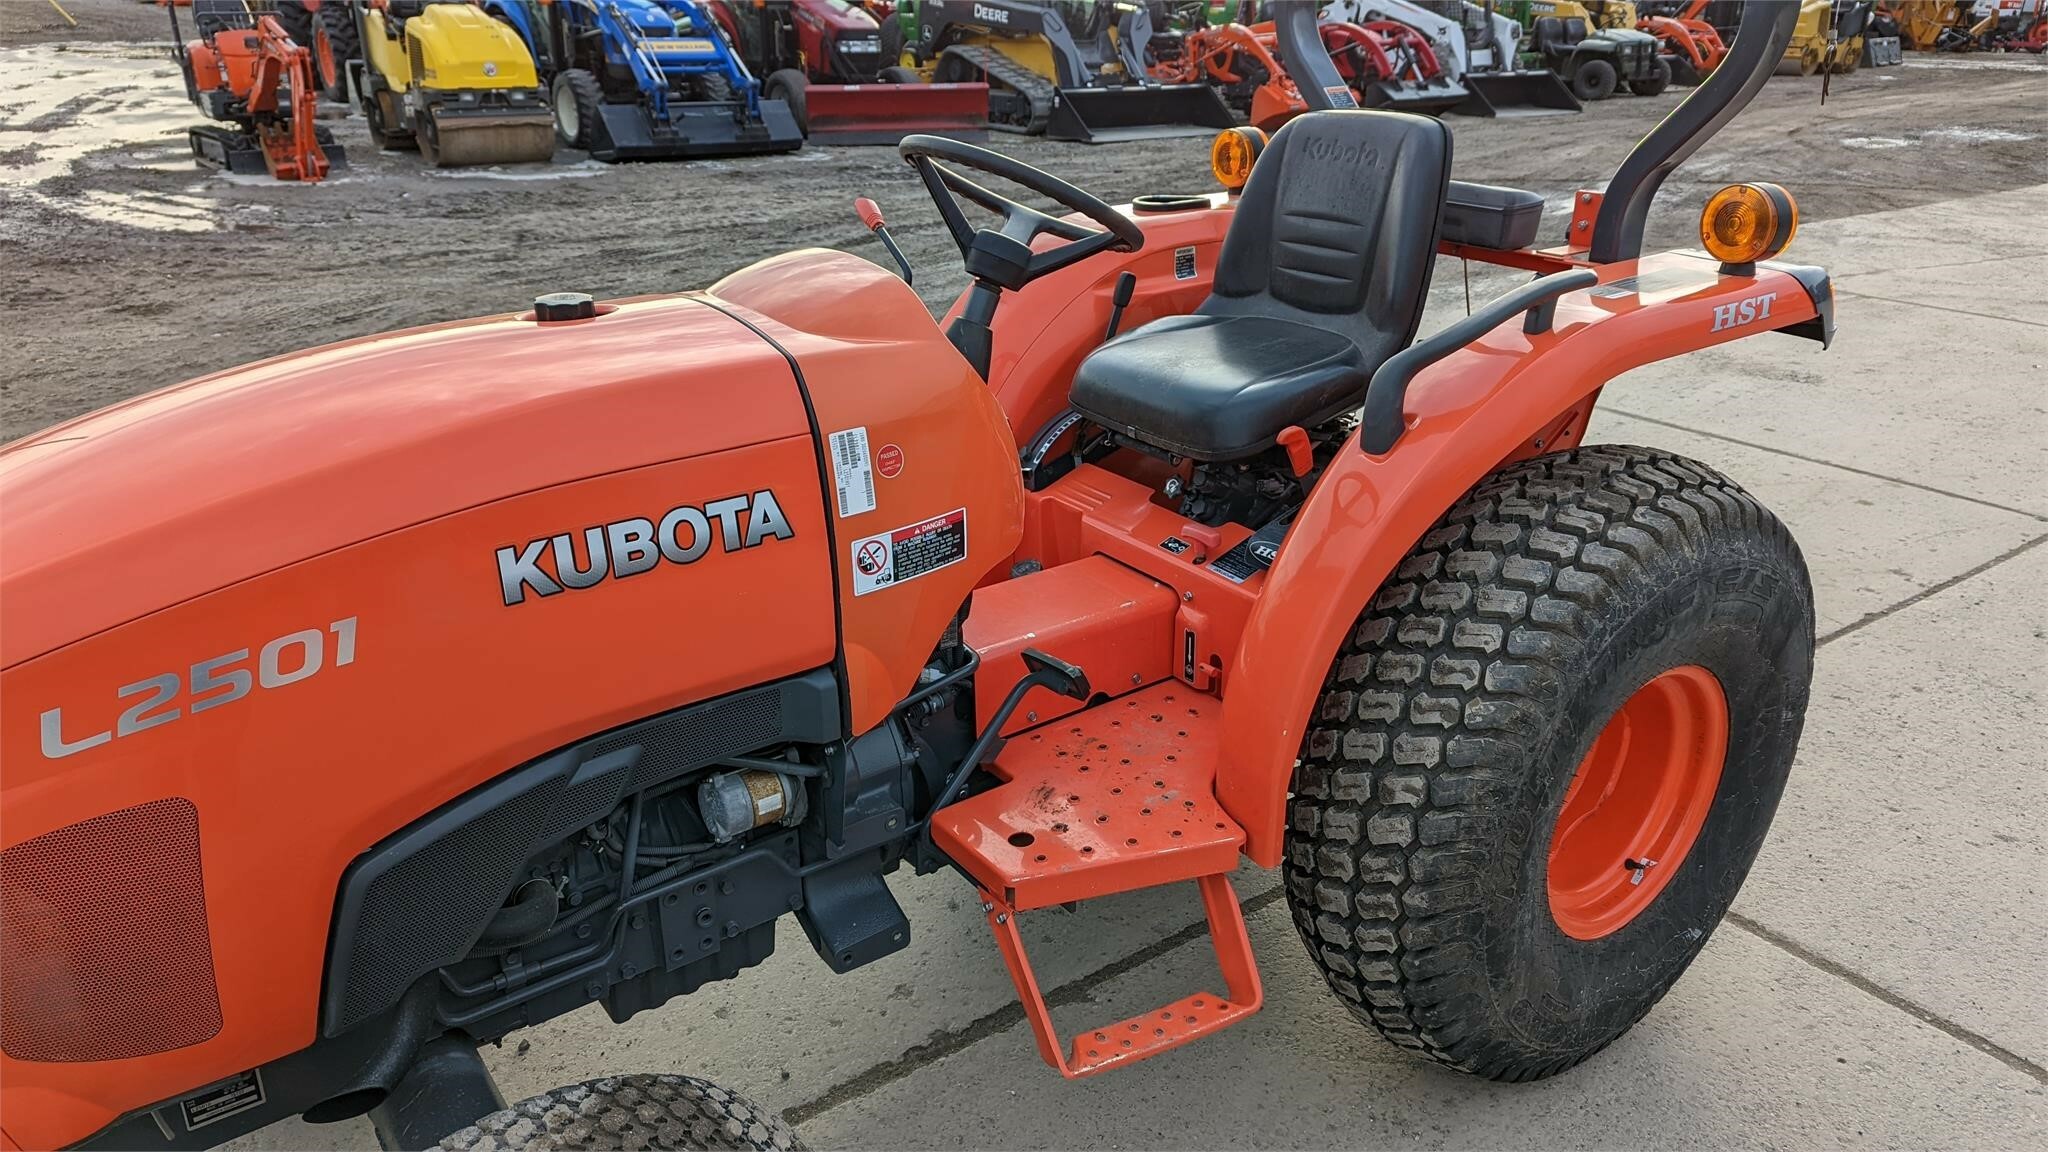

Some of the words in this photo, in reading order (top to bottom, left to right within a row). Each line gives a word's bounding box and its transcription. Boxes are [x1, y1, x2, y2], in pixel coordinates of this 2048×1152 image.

[974, 3, 1009, 24] DEERE
[1302, 136, 1380, 169] Kubota
[1710, 292, 1777, 333] HST
[921, 518, 946, 532] DANGER
[495, 488, 795, 607] KUBOTA
[1254, 545, 1278, 560] HS
[40, 616, 357, 759] L2501
